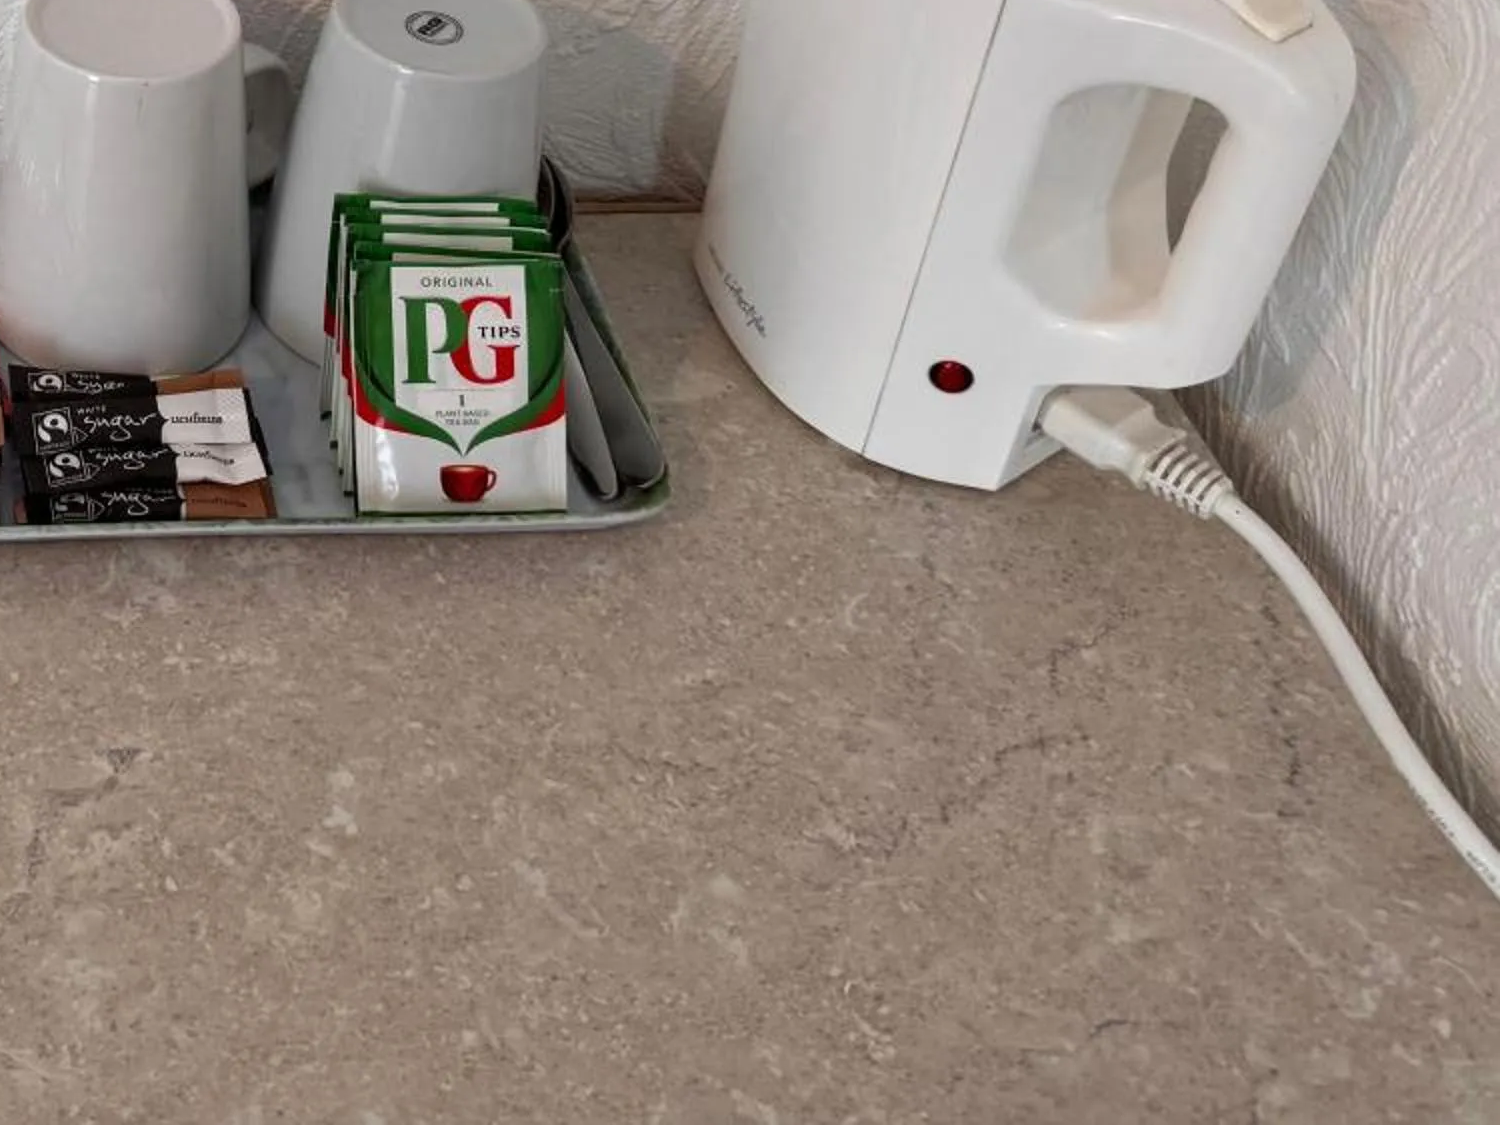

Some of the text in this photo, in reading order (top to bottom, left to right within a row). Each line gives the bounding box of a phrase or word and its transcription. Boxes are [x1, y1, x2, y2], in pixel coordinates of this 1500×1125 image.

[420, 276, 494, 289] ORIGINAL
[398, 295, 521, 385] PG
[477, 326, 521, 339] TIPS
[83, 412, 157, 442] sugar
[95, 448, 170, 471] sugar
[101, 491, 177, 516] sugar
